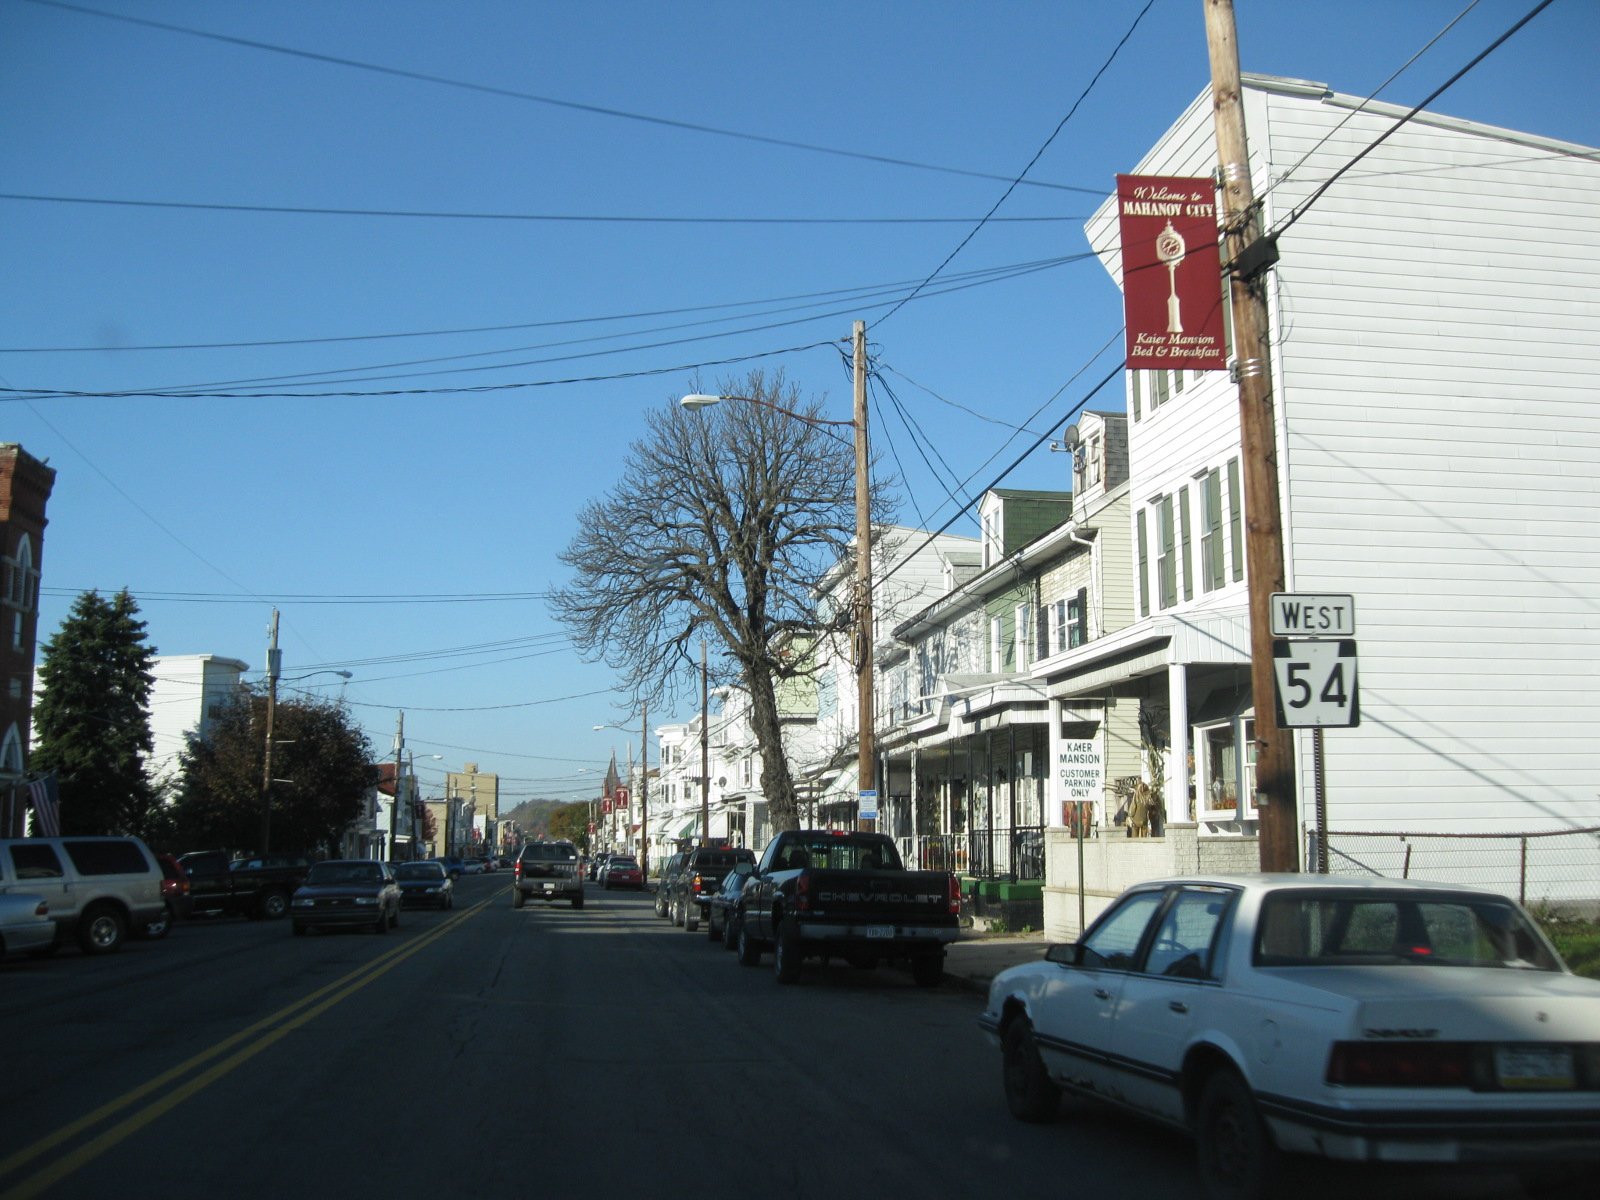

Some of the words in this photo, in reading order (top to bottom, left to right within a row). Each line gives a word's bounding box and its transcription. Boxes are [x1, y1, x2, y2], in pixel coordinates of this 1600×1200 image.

[1134, 186, 1187, 201] Welcome
[1191, 192, 1203, 201] to
[1123, 201, 1182, 216] MAHANOY
[1186, 204, 1214, 217] CITY
[1136, 333, 1166, 344] Kaier
[1168, 333, 1215, 344] Mansion
[1131, 345, 1154, 356] Bed
[1155, 345, 1168, 357] &
[1169, 346, 1220, 359] Breakfast
[1281, 602, 1344, 630] WEST
[1287, 662, 1348, 709] 54
[1067, 742, 1093, 752] KAIER
[1059, 754, 1100, 764] MANSION
[1060, 769, 1100, 778] CUSTOMER
[1064, 779, 1096, 788] PARKING
[1071, 788, 1090, 797] ONLY
[818, 892, 942, 904] CHEVROLET
